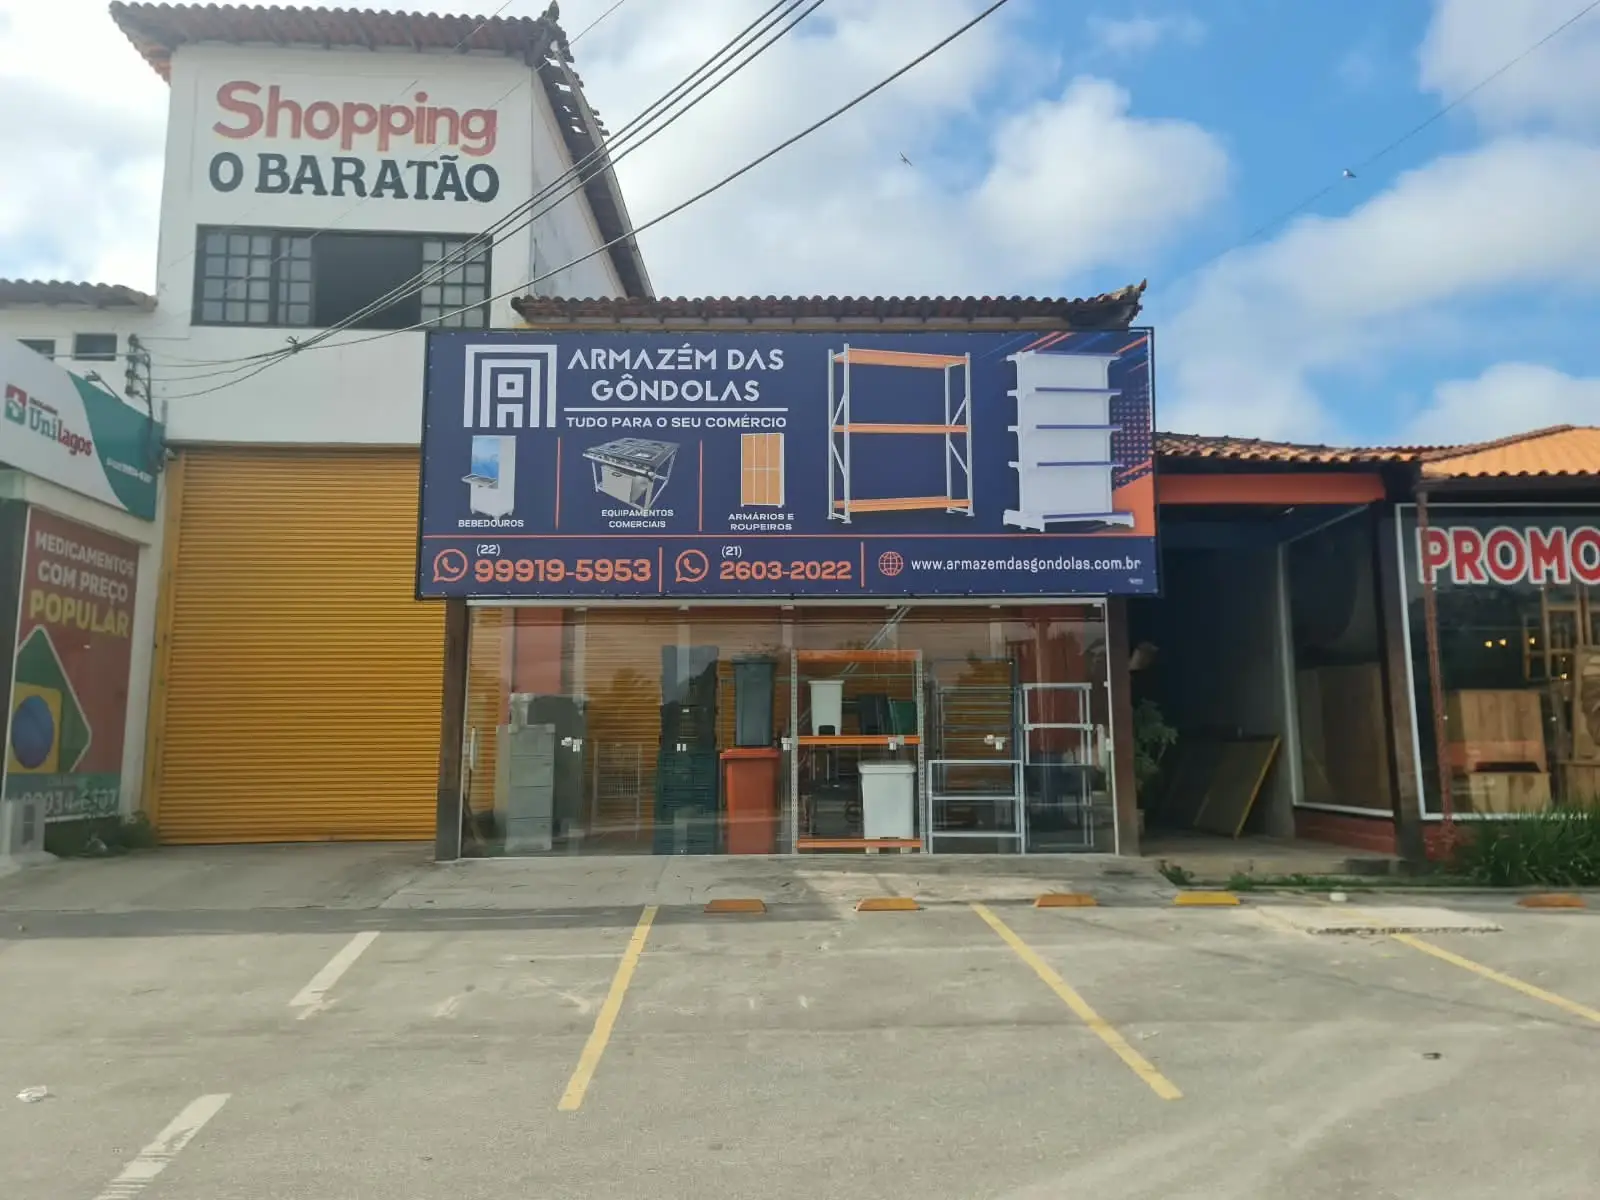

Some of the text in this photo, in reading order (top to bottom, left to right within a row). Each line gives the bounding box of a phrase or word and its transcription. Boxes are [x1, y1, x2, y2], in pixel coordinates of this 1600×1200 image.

[212, 80, 498, 157] Shopping
[209, 151, 500, 203] O BARATÃO
[567, 343, 785, 370] ARMAZÉM DAS
[591, 373, 761, 402] GÔNDOLAS
[565, 413, 787, 428] TUDO PARA O SEU COMÉRCIO
[601, 509, 674, 517] EQUIPAMENTOS
[728, 512, 795, 521] ARMÁRIOS E
[457, 519, 525, 528] BEBEDOUROS
[608, 520, 666, 528] COMERCIAIS
[730, 523, 792, 531] ROUPEIROS
[35, 530, 135, 577] MEDICAMENTOS
[476, 544, 501, 556] (22)
[721, 545, 742, 558] (21)
[1415, 526, 1600, 585] PROMO
[474, 559, 652, 582] 99919-5953
[719, 561, 852, 581] 2603-2022
[911, 556, 1141, 573] www.armazemdasgondolas.com.br
[38, 559, 128, 607] COM PREÇO
[29, 588, 130, 638] POPULAR
